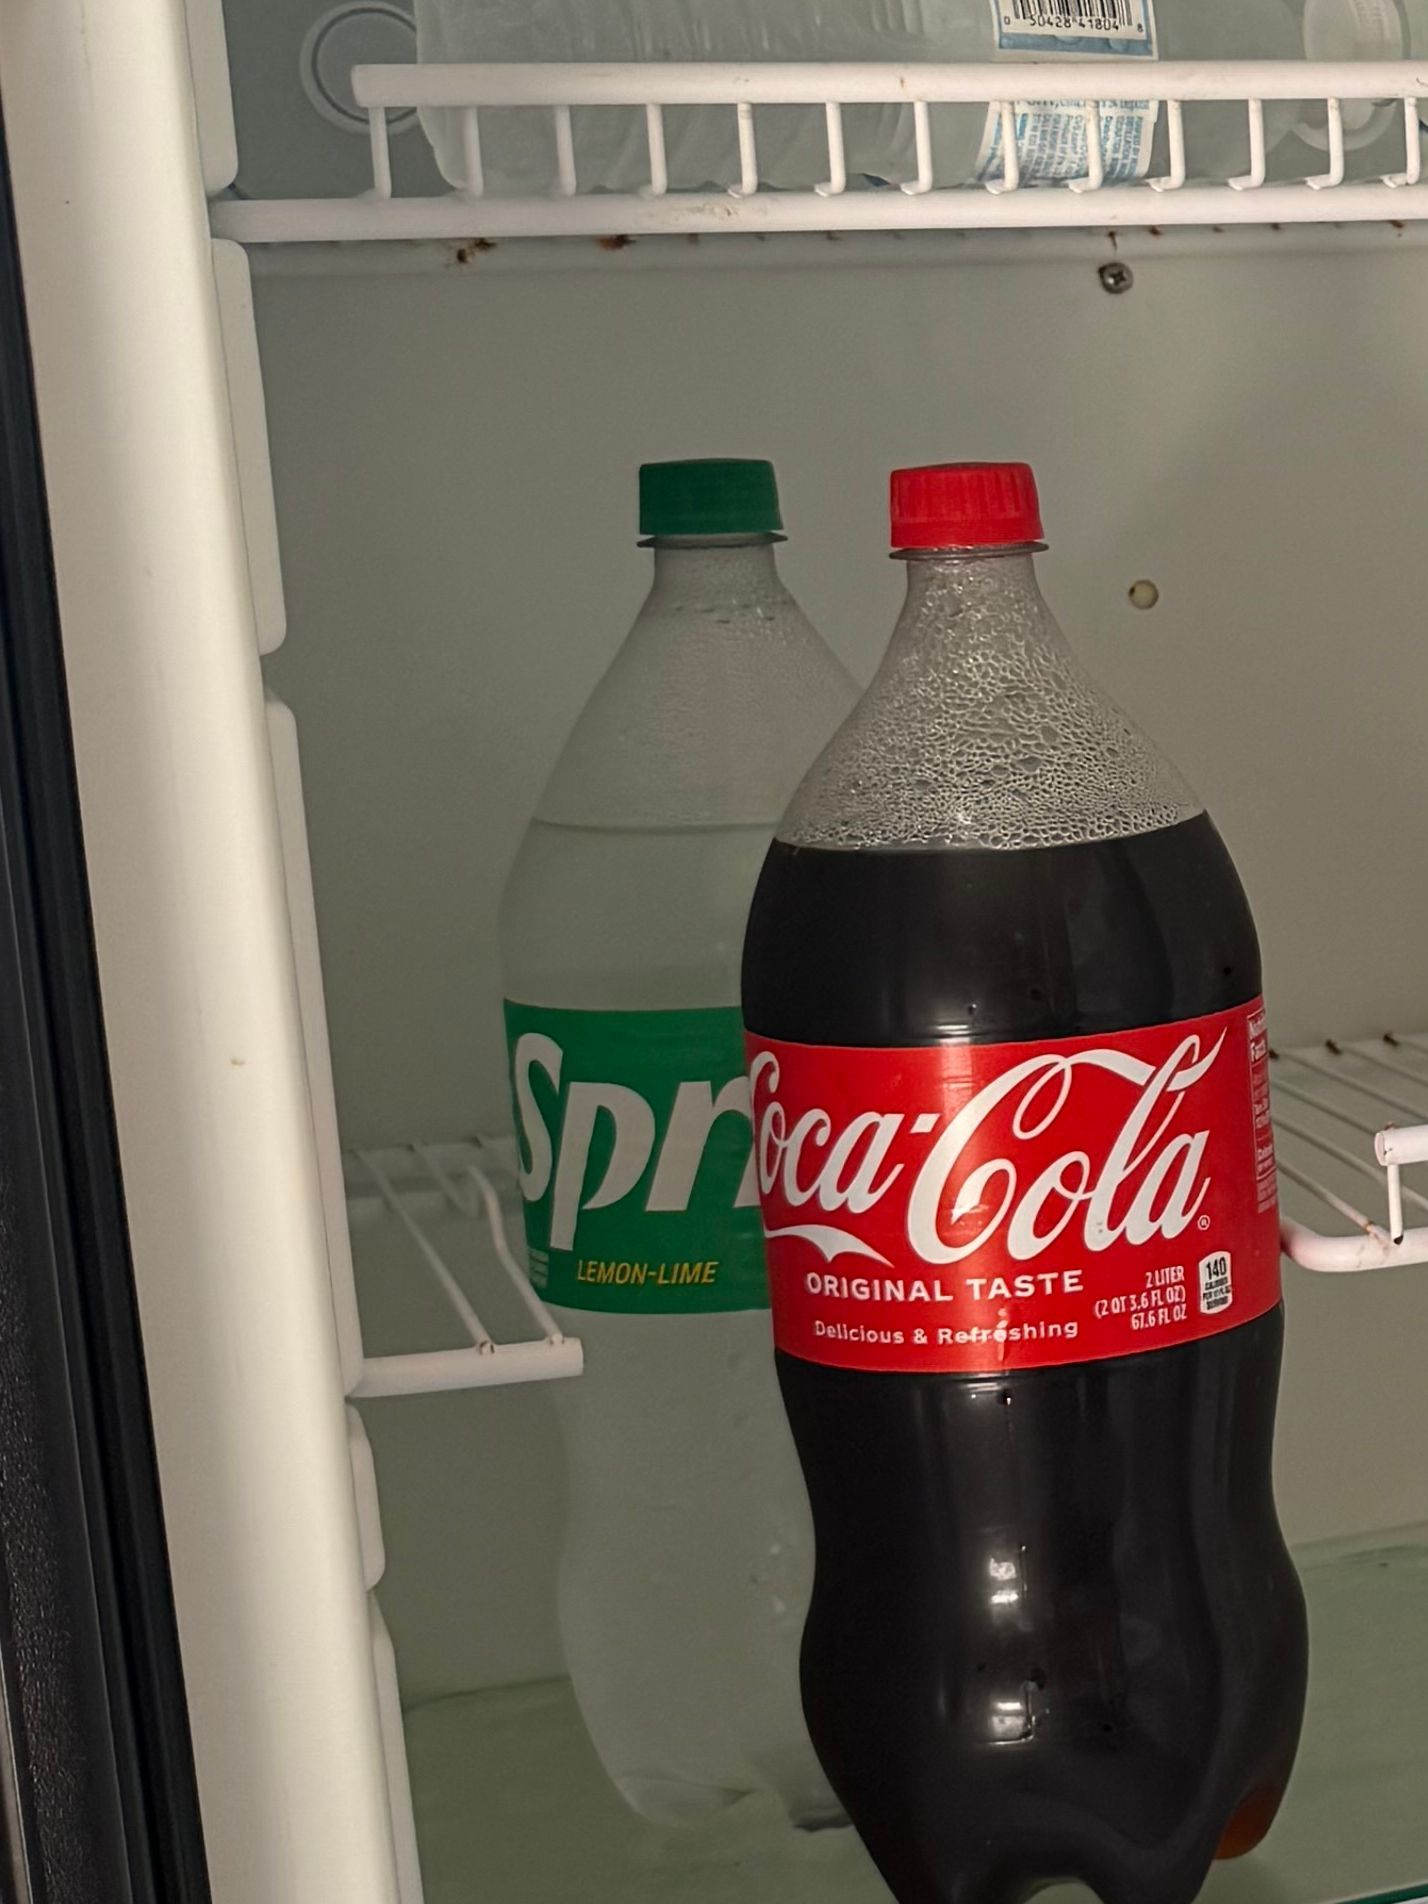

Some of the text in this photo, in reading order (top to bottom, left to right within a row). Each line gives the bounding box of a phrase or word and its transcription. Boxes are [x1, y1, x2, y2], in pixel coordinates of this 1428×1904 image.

[1004, 16, 1011, 26] 0
[577, 1259, 719, 1285] LEMON-LIME
[1154, 1265, 1185, 1287] LITER
[1206, 1256, 1228, 1280] 140
[804, 1270, 1085, 1304] ORIGINAL TASTE
[1151, 1290, 1164, 1307] FL
[1131, 1303, 1188, 1330] 67.6 FL OZ
[813, 1318, 1079, 1346] Delicious & Refreshing
